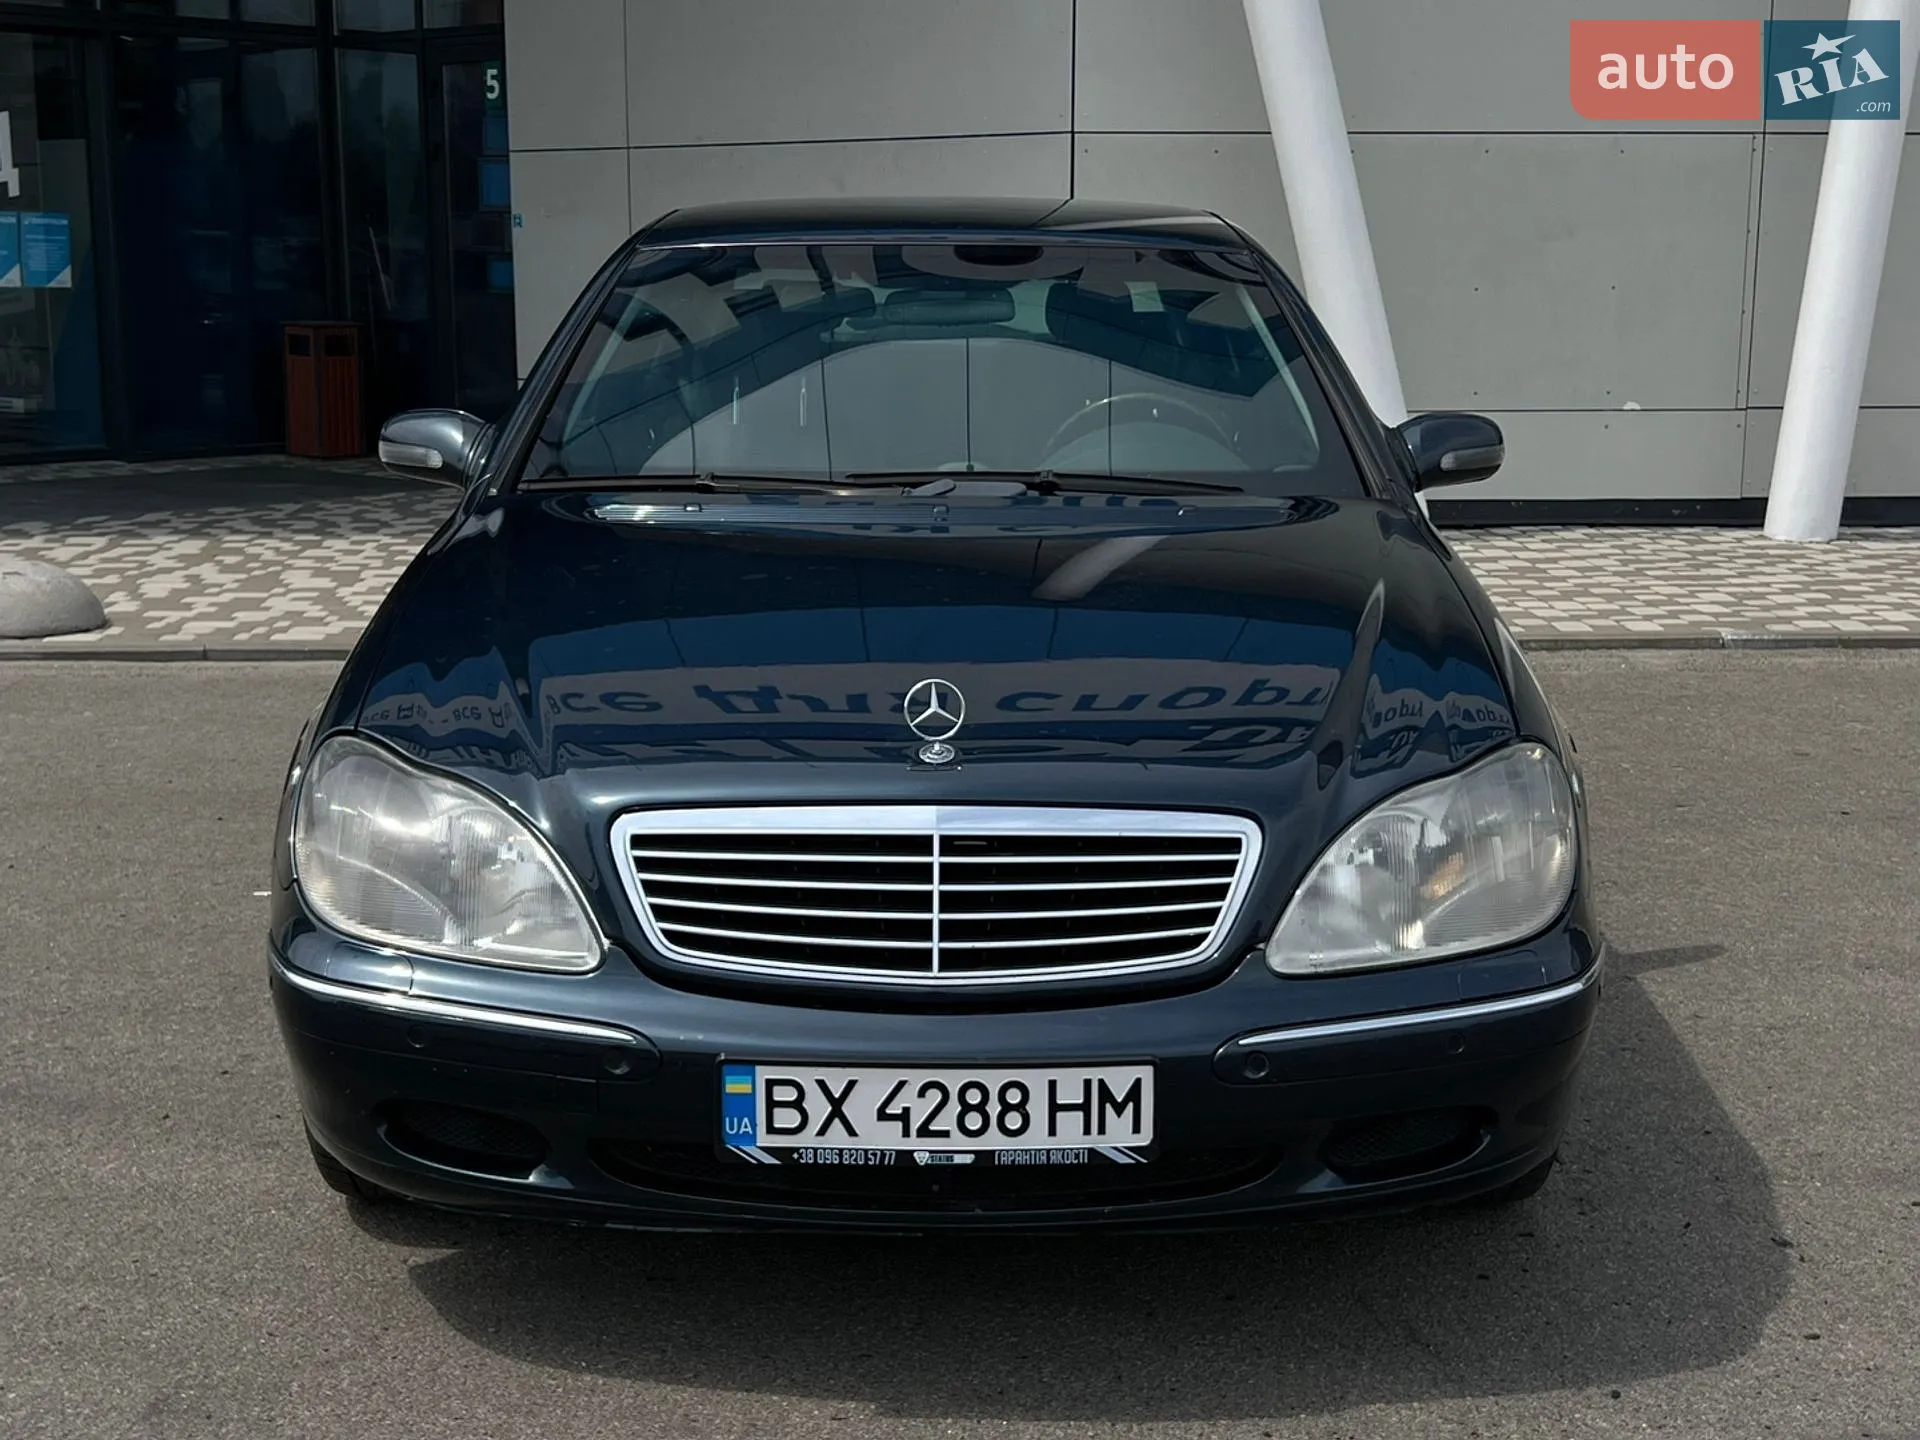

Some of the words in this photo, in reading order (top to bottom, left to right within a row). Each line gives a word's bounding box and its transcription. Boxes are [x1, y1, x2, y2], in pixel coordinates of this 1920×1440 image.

[485, 69, 500, 100] 5
[764, 1077, 860, 1138] BX
[875, 1078, 1031, 1139] 4288
[1047, 1077, 1143, 1138] HM
[725, 1116, 753, 1135] UA
[792, 1149, 815, 1165] +38
[817, 1150, 840, 1165] 096
[842, 1150, 865, 1166] 820
[994, 1149, 1048, 1166] ГАРАНТІЯ
[1049, 1148, 1089, 1164] ЯКОСТІ
